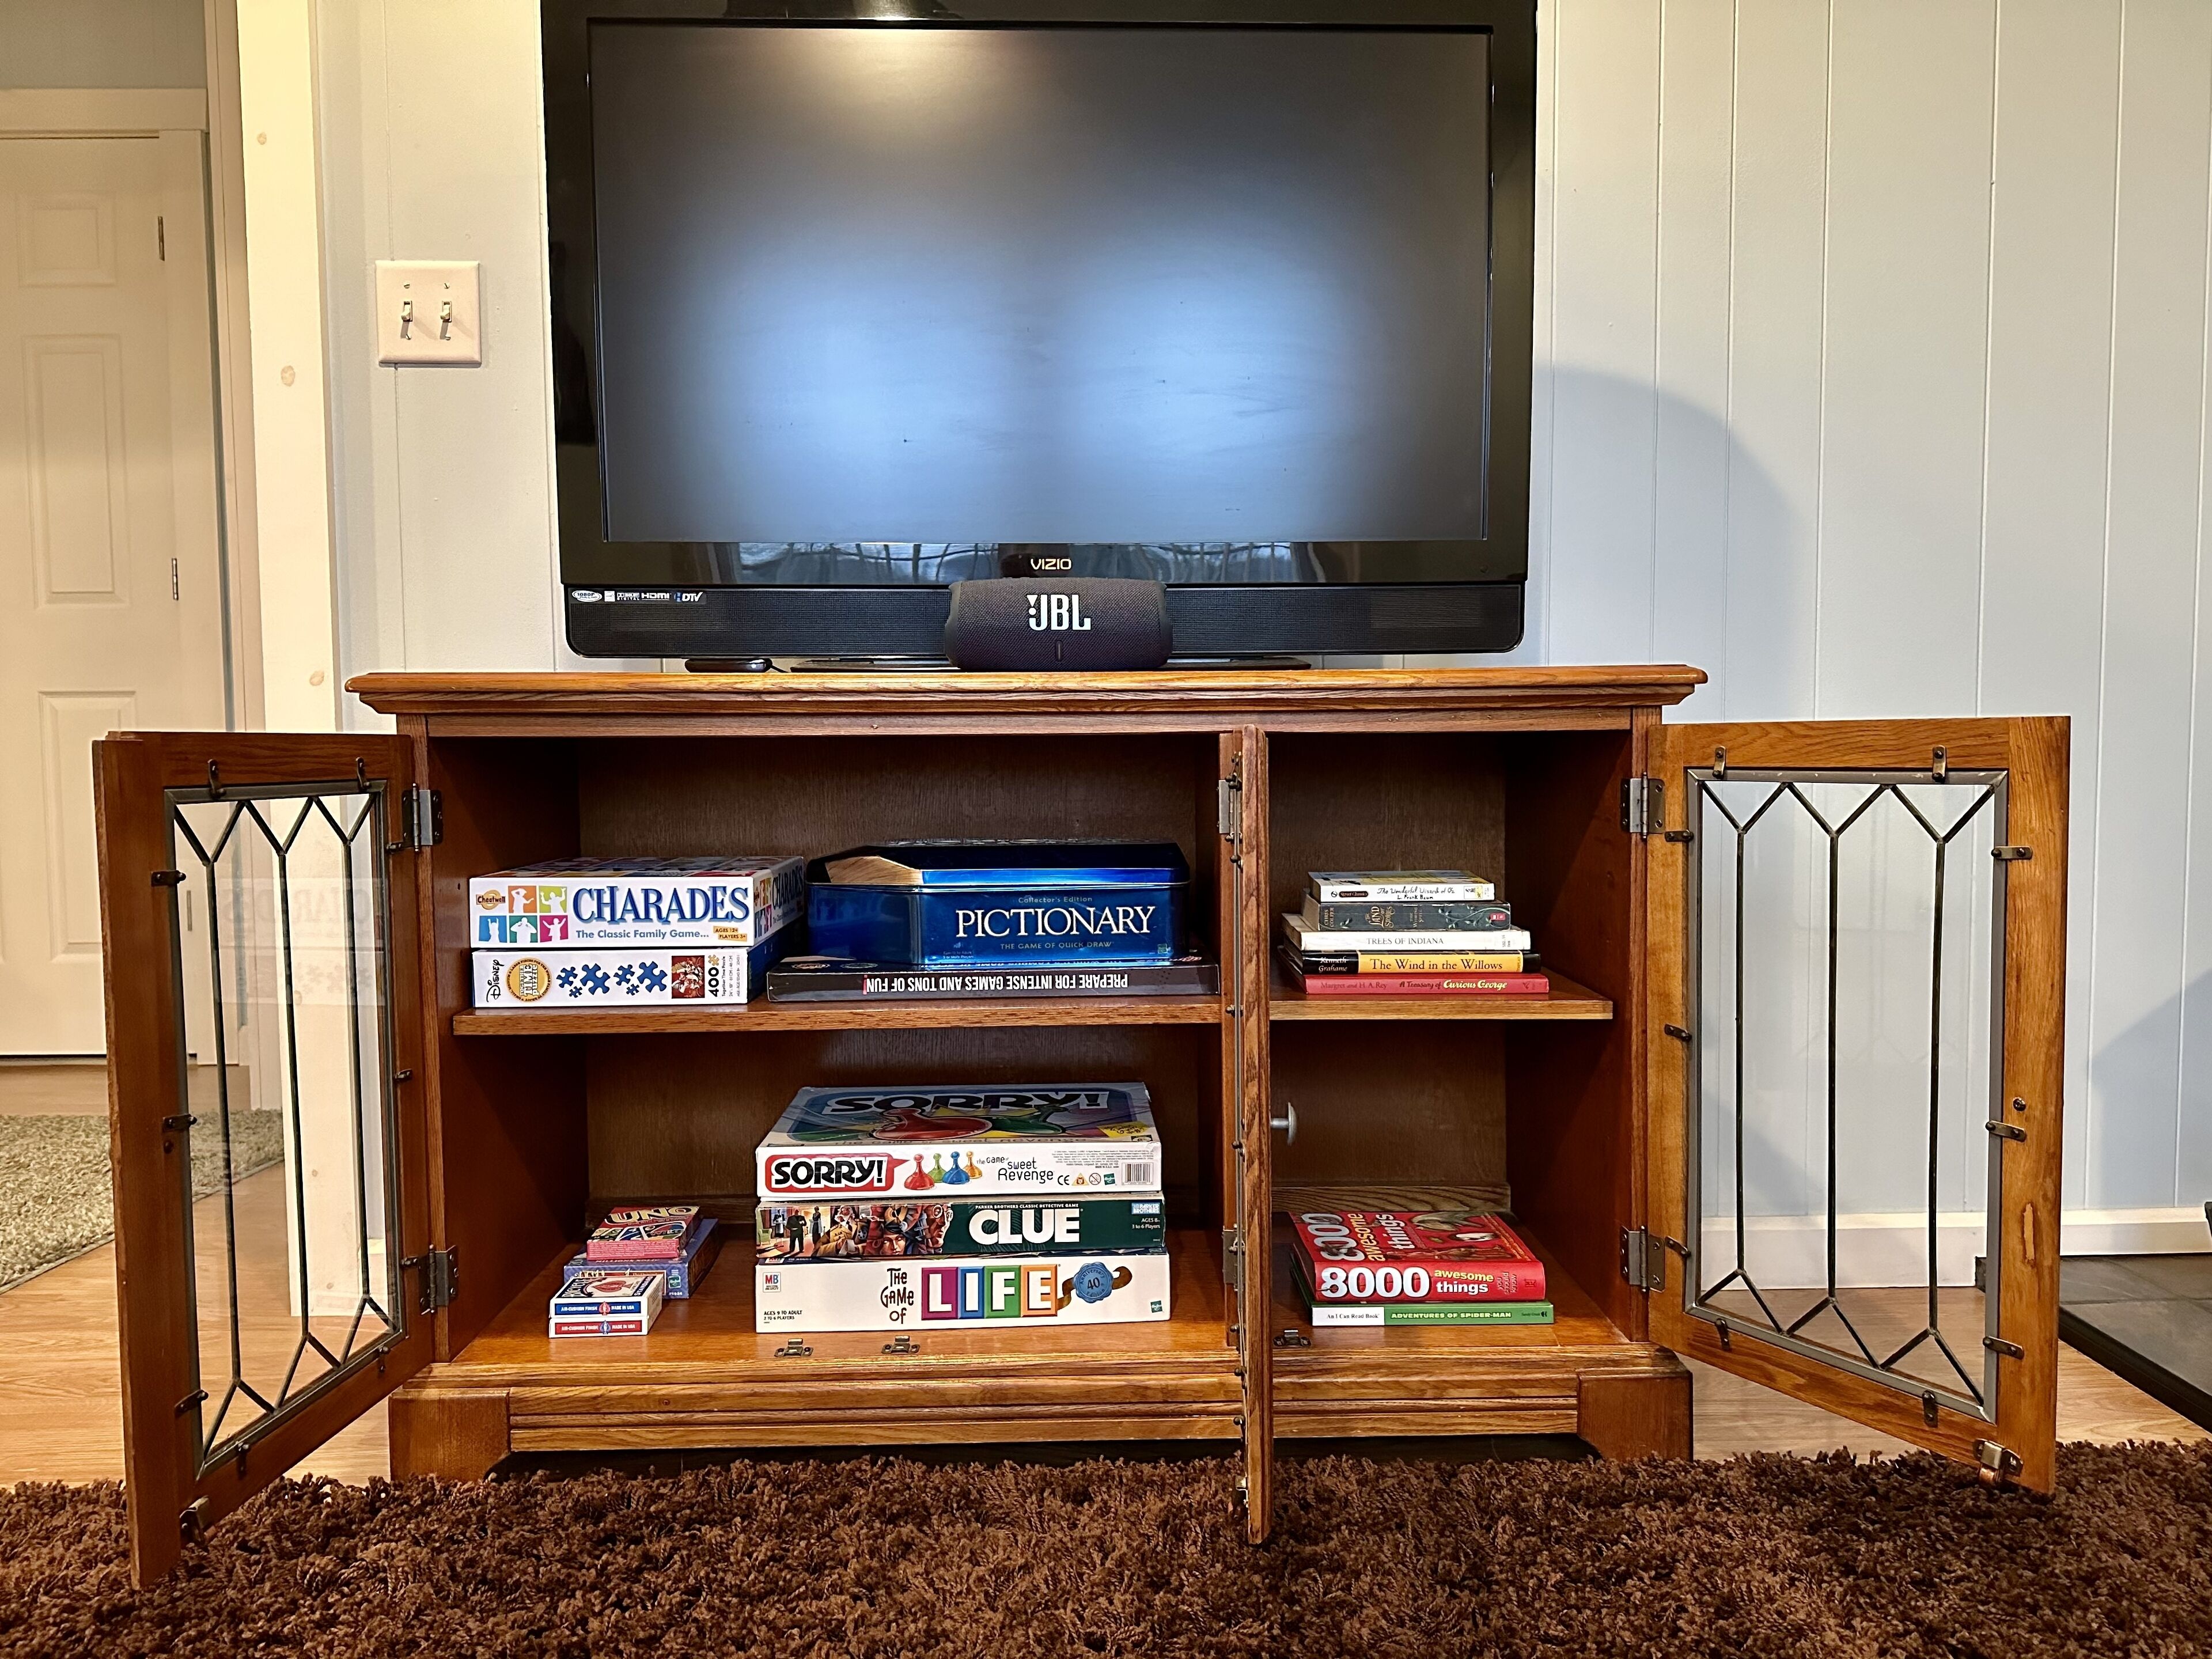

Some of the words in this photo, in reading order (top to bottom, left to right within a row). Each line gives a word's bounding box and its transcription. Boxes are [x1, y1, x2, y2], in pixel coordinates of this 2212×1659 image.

[1030, 558, 1072, 570] VIZIO
[1027, 594, 1091, 631] JBL
[1390, 885, 1418, 894] Wonderful
[478, 895, 506, 904] Cheatwell
[573, 885, 750, 925] CHARADES
[956, 906, 1156, 938] PICTIONARY
[1369, 906, 1384, 928] LAND
[576, 930, 594, 938] The
[597, 929, 631, 938] Classic
[633, 929, 666, 940] Family
[669, 929, 710, 938] Game...
[1059, 941, 1084, 949] QUICK
[1370, 959, 1392, 969] The
[1394, 959, 1425, 969] Wind
[1429, 960, 1438, 969] in
[1442, 960, 1457, 969] the
[1461, 959, 1503, 969] Willows
[486, 959, 505, 1002] Disney
[524, 963, 533, 997] TIME
[532, 964, 540, 997] puzzle
[708, 967, 719, 997] 400
[862, 974, 888, 995] FUN!
[891, 978, 905, 993] OF
[907, 977, 937, 992] TONS
[940, 976, 963, 991] AND
[965, 975, 1004, 991] GAMES
[1006, 975, 1053, 990] INTENSE
[1055, 974, 1077, 990] FOR
[1078, 973, 1128, 988] PREPARE
[1320, 982, 1346, 990] Margret
[1407, 981, 1433, 989] Treasury
[1435, 980, 1441, 990] of
[1442, 980, 1476, 989] Curious
[1477, 979, 1508, 991] George
[828, 1092, 1103, 1113] SORRY!
[1007, 1157, 1037, 1170] sweet
[774, 1160, 884, 1185] SORRY!
[998, 1168, 1054, 1184] Revenge
[608, 1206, 700, 1223] UNO
[969, 1208, 1080, 1245] CLUE
[1376, 1214, 1416, 1249] things
[1301, 1213, 1366, 1262] 8000
[1347, 1213, 1386, 1262] awesome
[765, 1274, 779, 1284] MB
[1079, 1268, 1107, 1285] Anniversary
[1086, 1277, 1100, 1290] 40
[1321, 1266, 1430, 1298] 8000
[1434, 1270, 1495, 1282] awesome
[562, 1277, 588, 1297] BICYCLE
[634, 1275, 653, 1296] STANDARD
[927, 1270, 1052, 1312] LIFE
[1435, 1281, 1488, 1295] things
